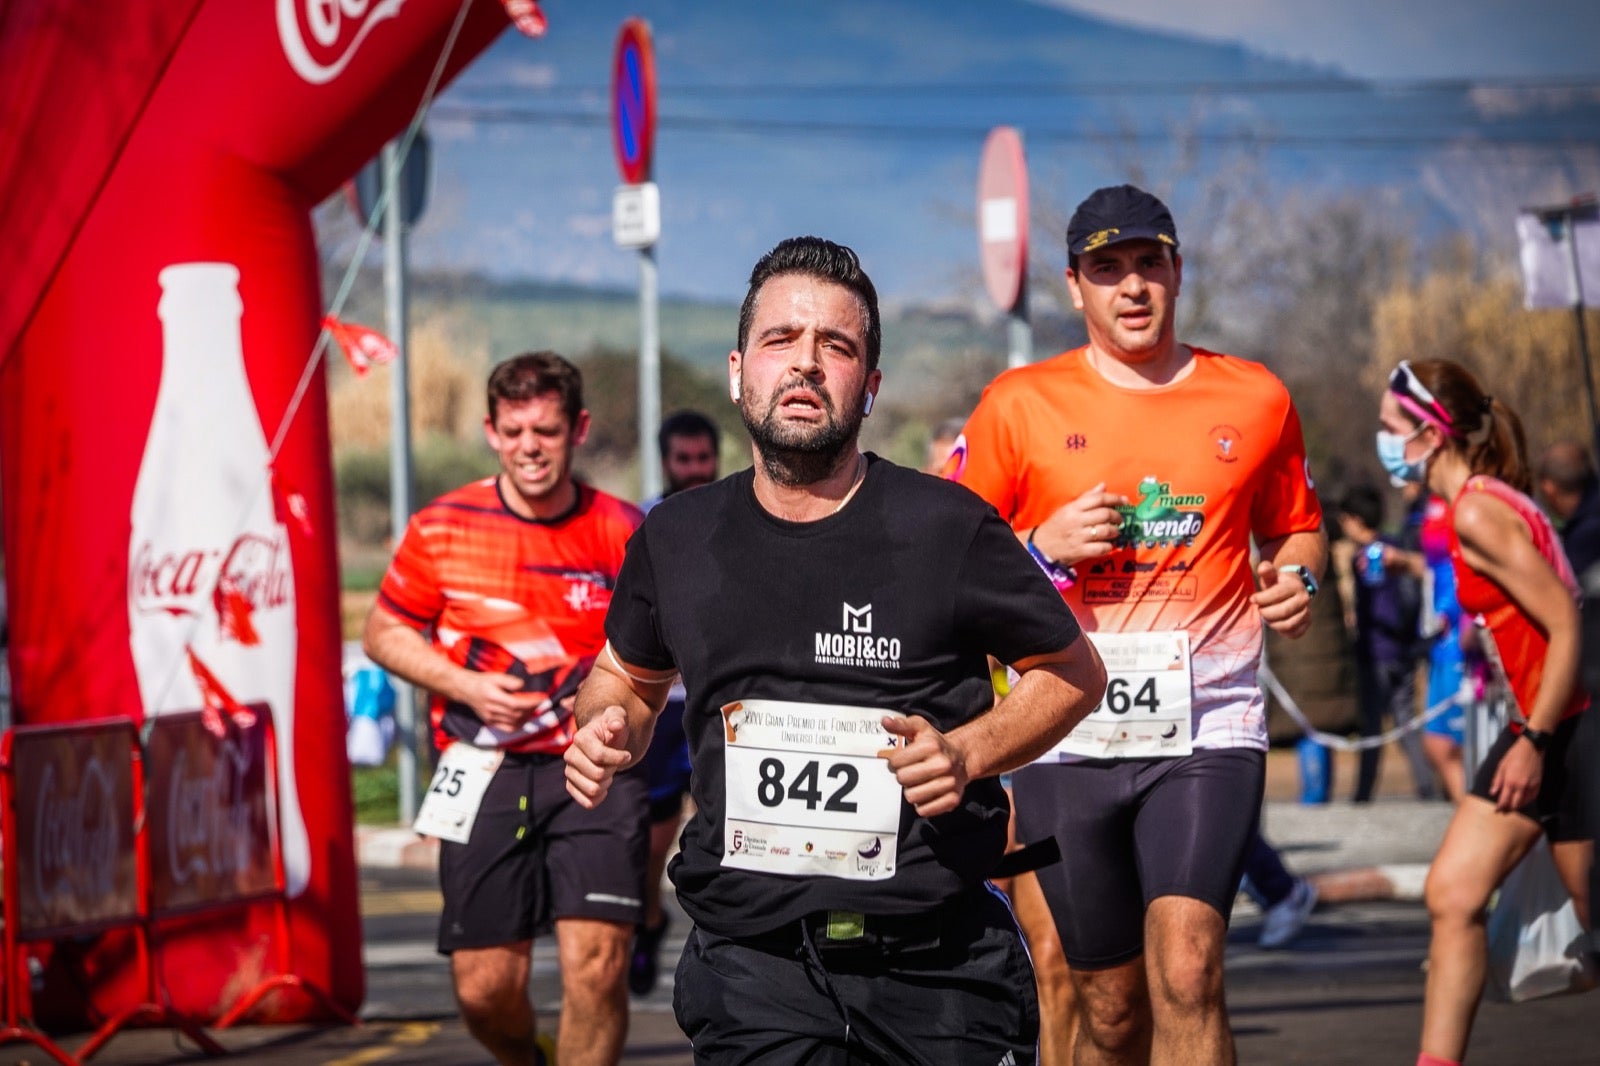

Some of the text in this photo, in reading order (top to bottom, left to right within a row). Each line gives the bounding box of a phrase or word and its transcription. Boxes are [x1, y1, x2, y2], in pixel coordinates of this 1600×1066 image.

[1160, 495, 1205, 508] mano
[815, 632, 901, 661] MOBI&CO
[815, 655, 855, 667] FABRICANTES
[856, 658, 864, 667] DE
[1092, 677, 1160, 715] 64
[787, 714, 816, 730] PREMIO
[831, 717, 857, 733] FONDO
[781, 730, 836, 745] UNIVERSO LORCA
[433, 765, 466, 797] 25
[757, 757, 860, 814] 842
